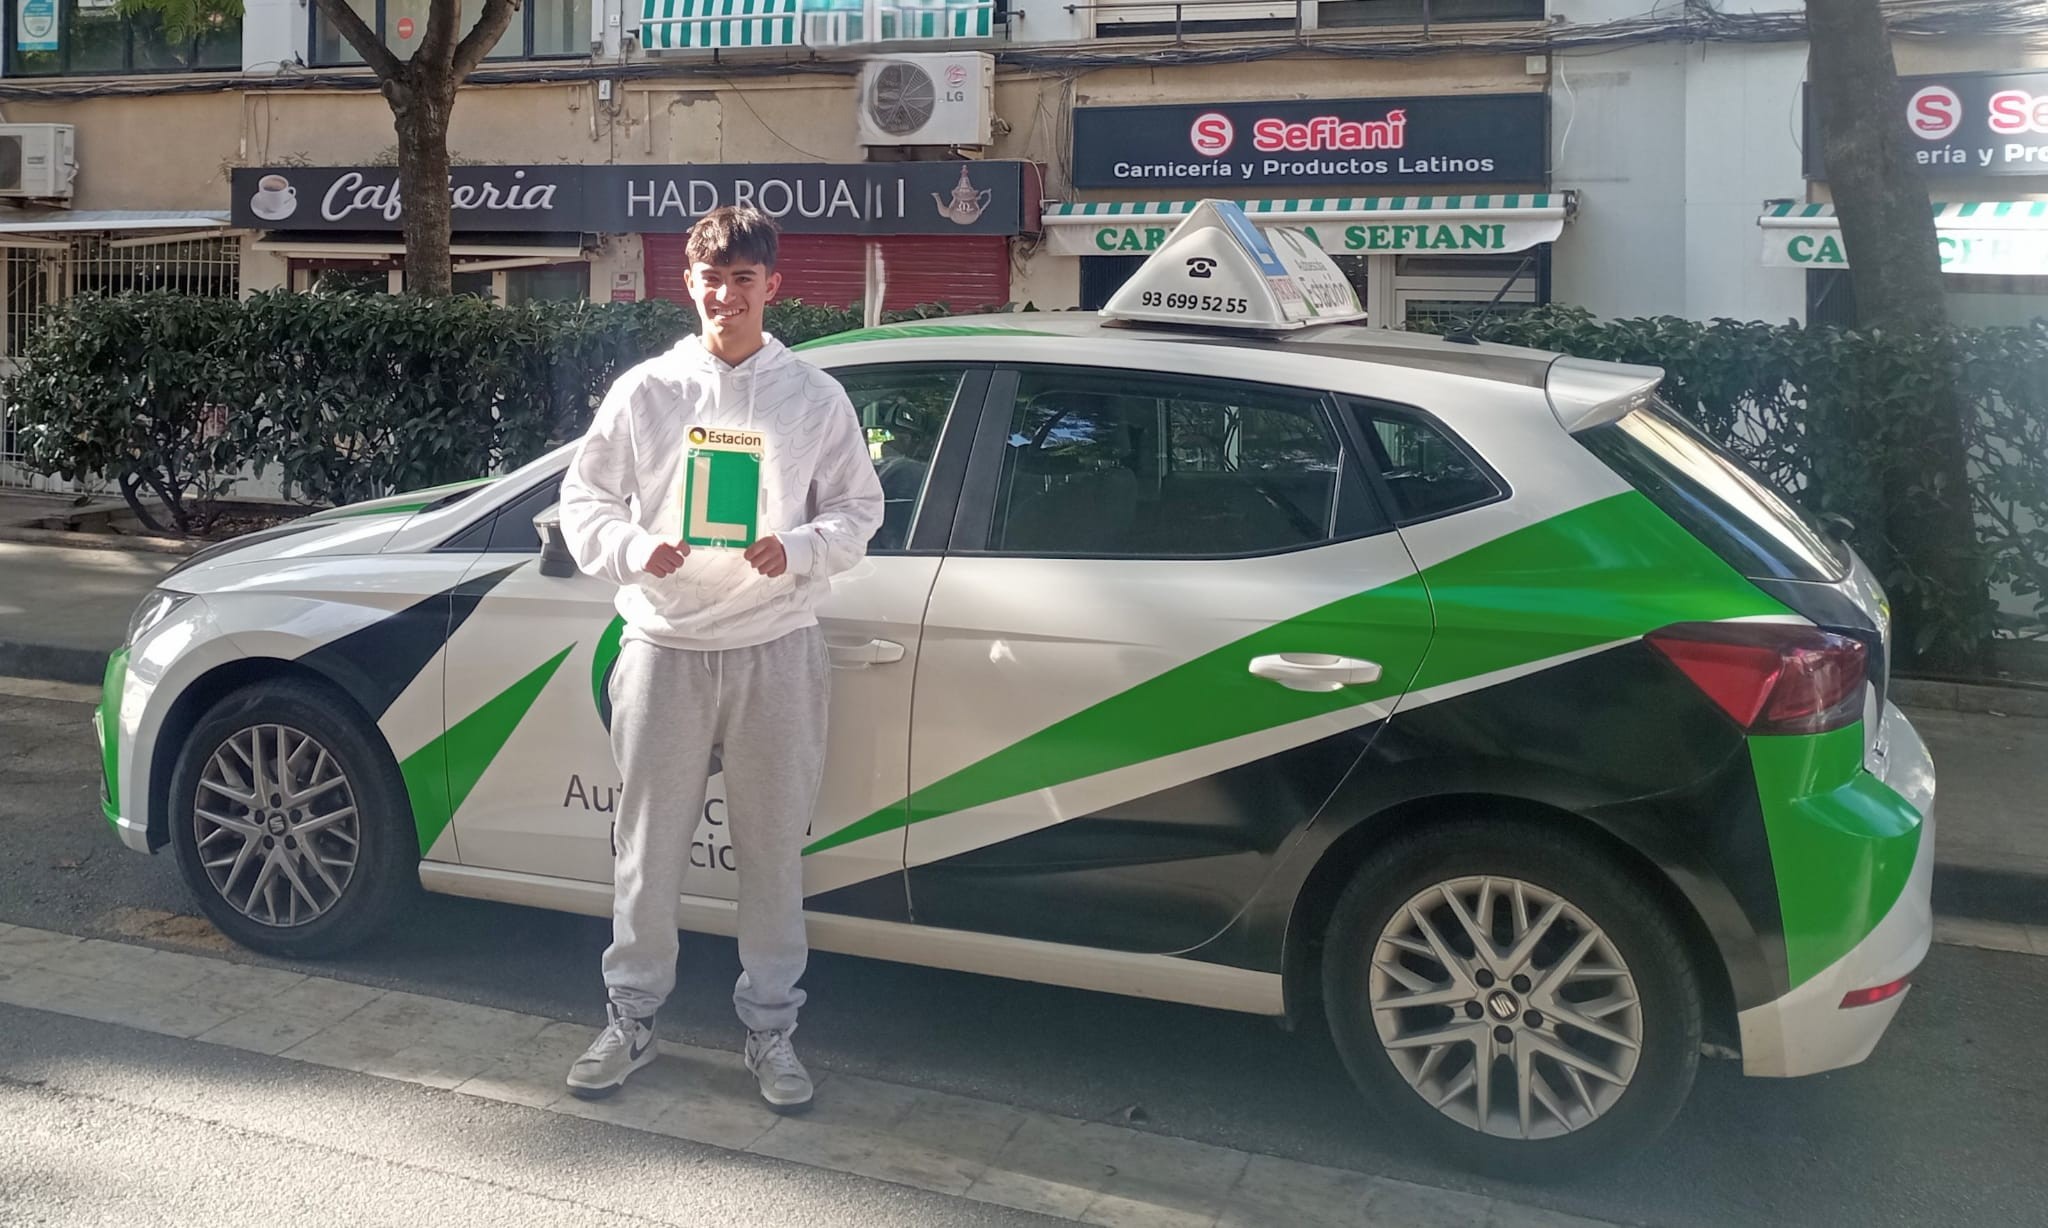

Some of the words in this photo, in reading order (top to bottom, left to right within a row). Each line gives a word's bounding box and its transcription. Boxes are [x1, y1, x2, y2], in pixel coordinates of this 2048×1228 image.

[946, 91, 964, 102] LG
[1253, 109, 1408, 151] Sefiani
[1113, 160, 1232, 178] Carnicería
[1241, 163, 1254, 179] y
[1263, 158, 1388, 176] Productos
[1399, 156, 1495, 174] Latinos
[1978, 147, 1994, 167] y
[321, 170, 557, 222] Caferia
[627, 180, 718, 218] HAD
[1345, 224, 1506, 250] SEFIANI
[1142, 291, 1162, 307] 93
[1166, 293, 1198, 310] 699
[1201, 296, 1223, 312] 52
[1226, 298, 1248, 314] 55
[708, 431, 761, 446] Estacion
[688, 456, 748, 541] L
